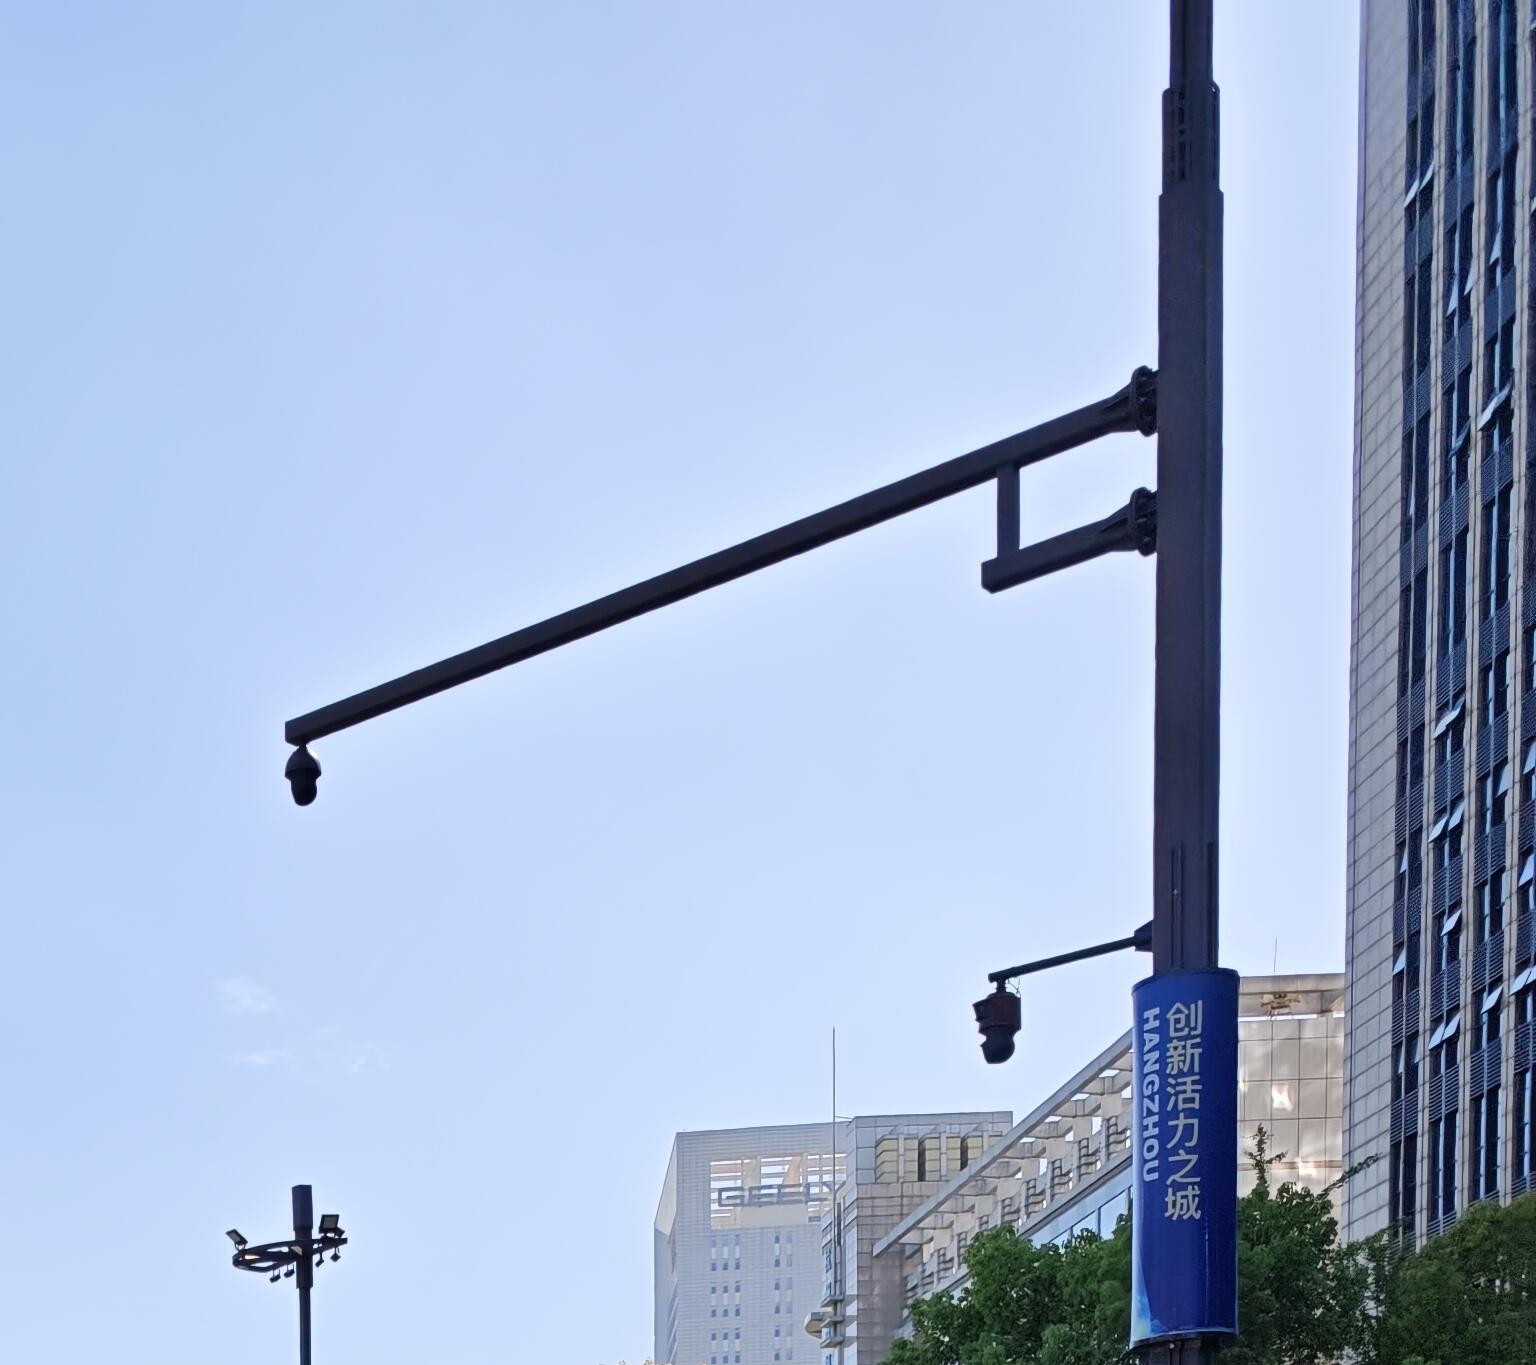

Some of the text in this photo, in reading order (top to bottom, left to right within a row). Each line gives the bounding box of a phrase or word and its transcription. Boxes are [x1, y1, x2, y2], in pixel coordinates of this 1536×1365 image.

[1143, 1007, 1160, 1182] HANGZHOU
[1165, 1000, 1203, 1221] 创新活力之城
